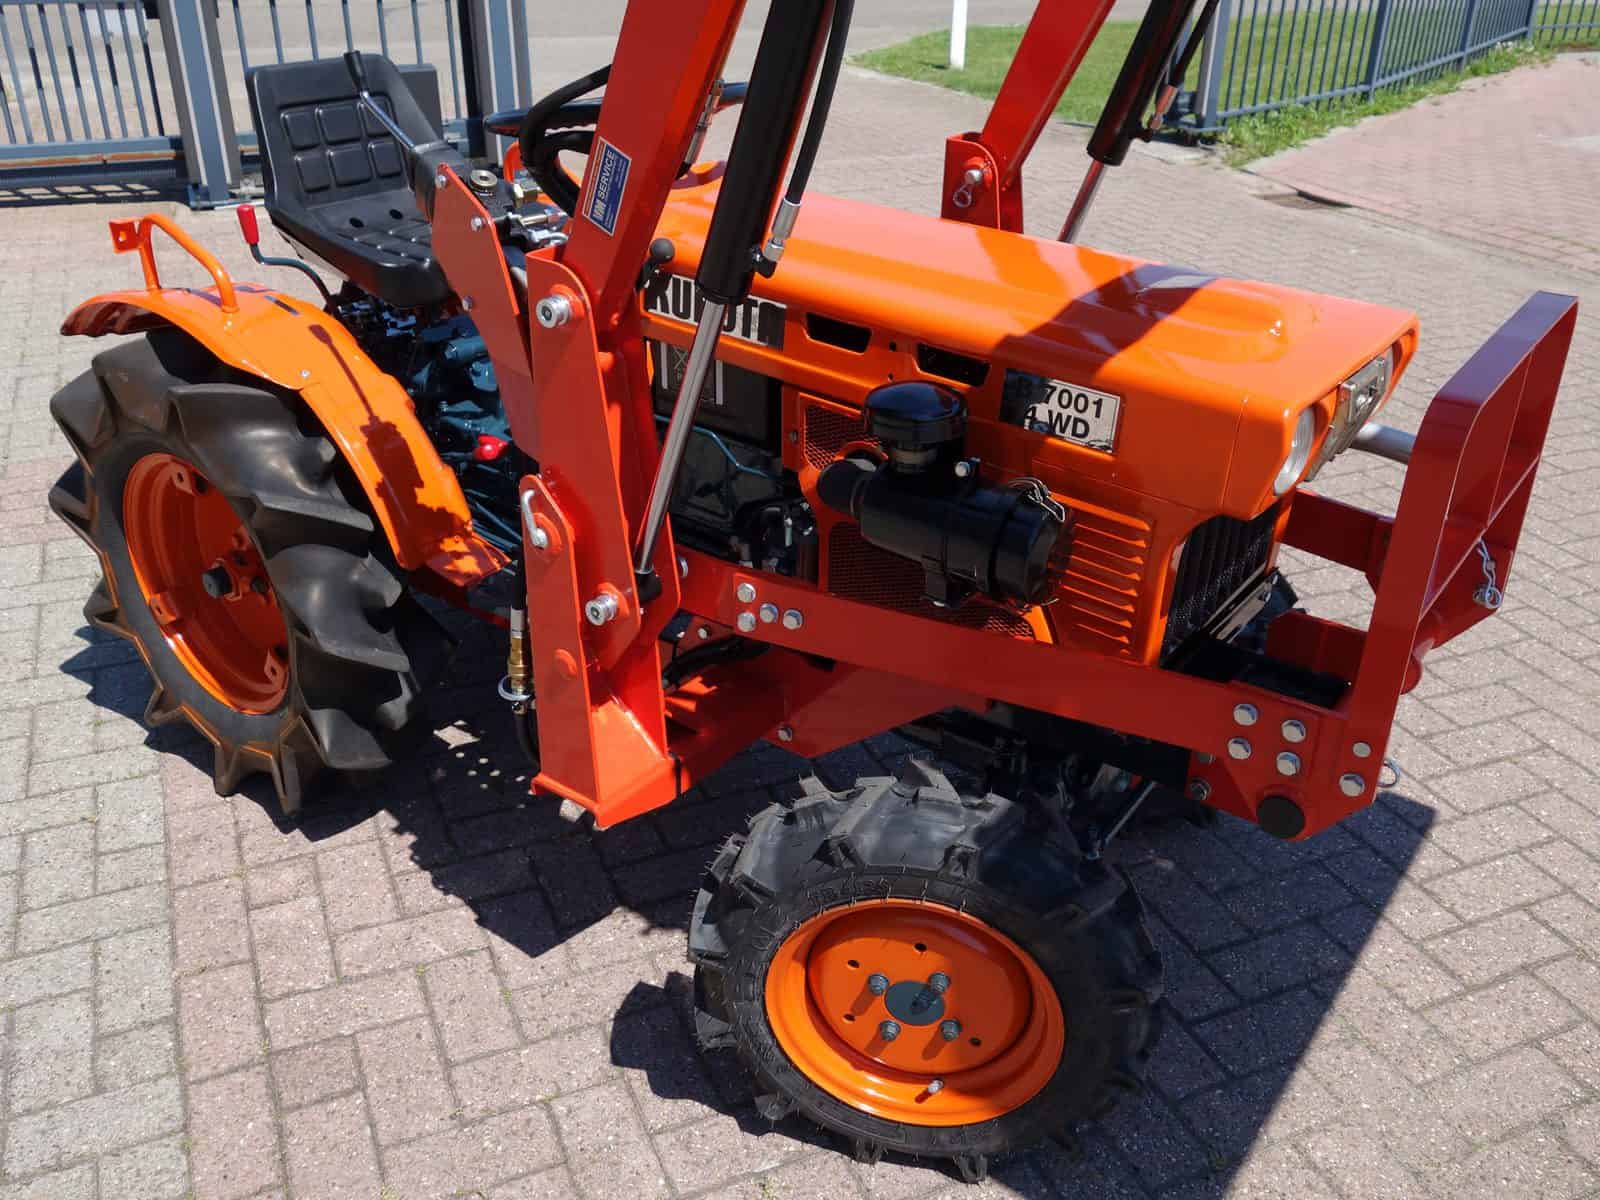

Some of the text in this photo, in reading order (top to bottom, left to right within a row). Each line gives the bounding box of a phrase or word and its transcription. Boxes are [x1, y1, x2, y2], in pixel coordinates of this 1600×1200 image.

[599, 150, 615, 200] SERVICE
[646, 274, 785, 348] KUT
[1040, 384, 1103, 419] 7001
[1047, 410, 1090, 438] WD
